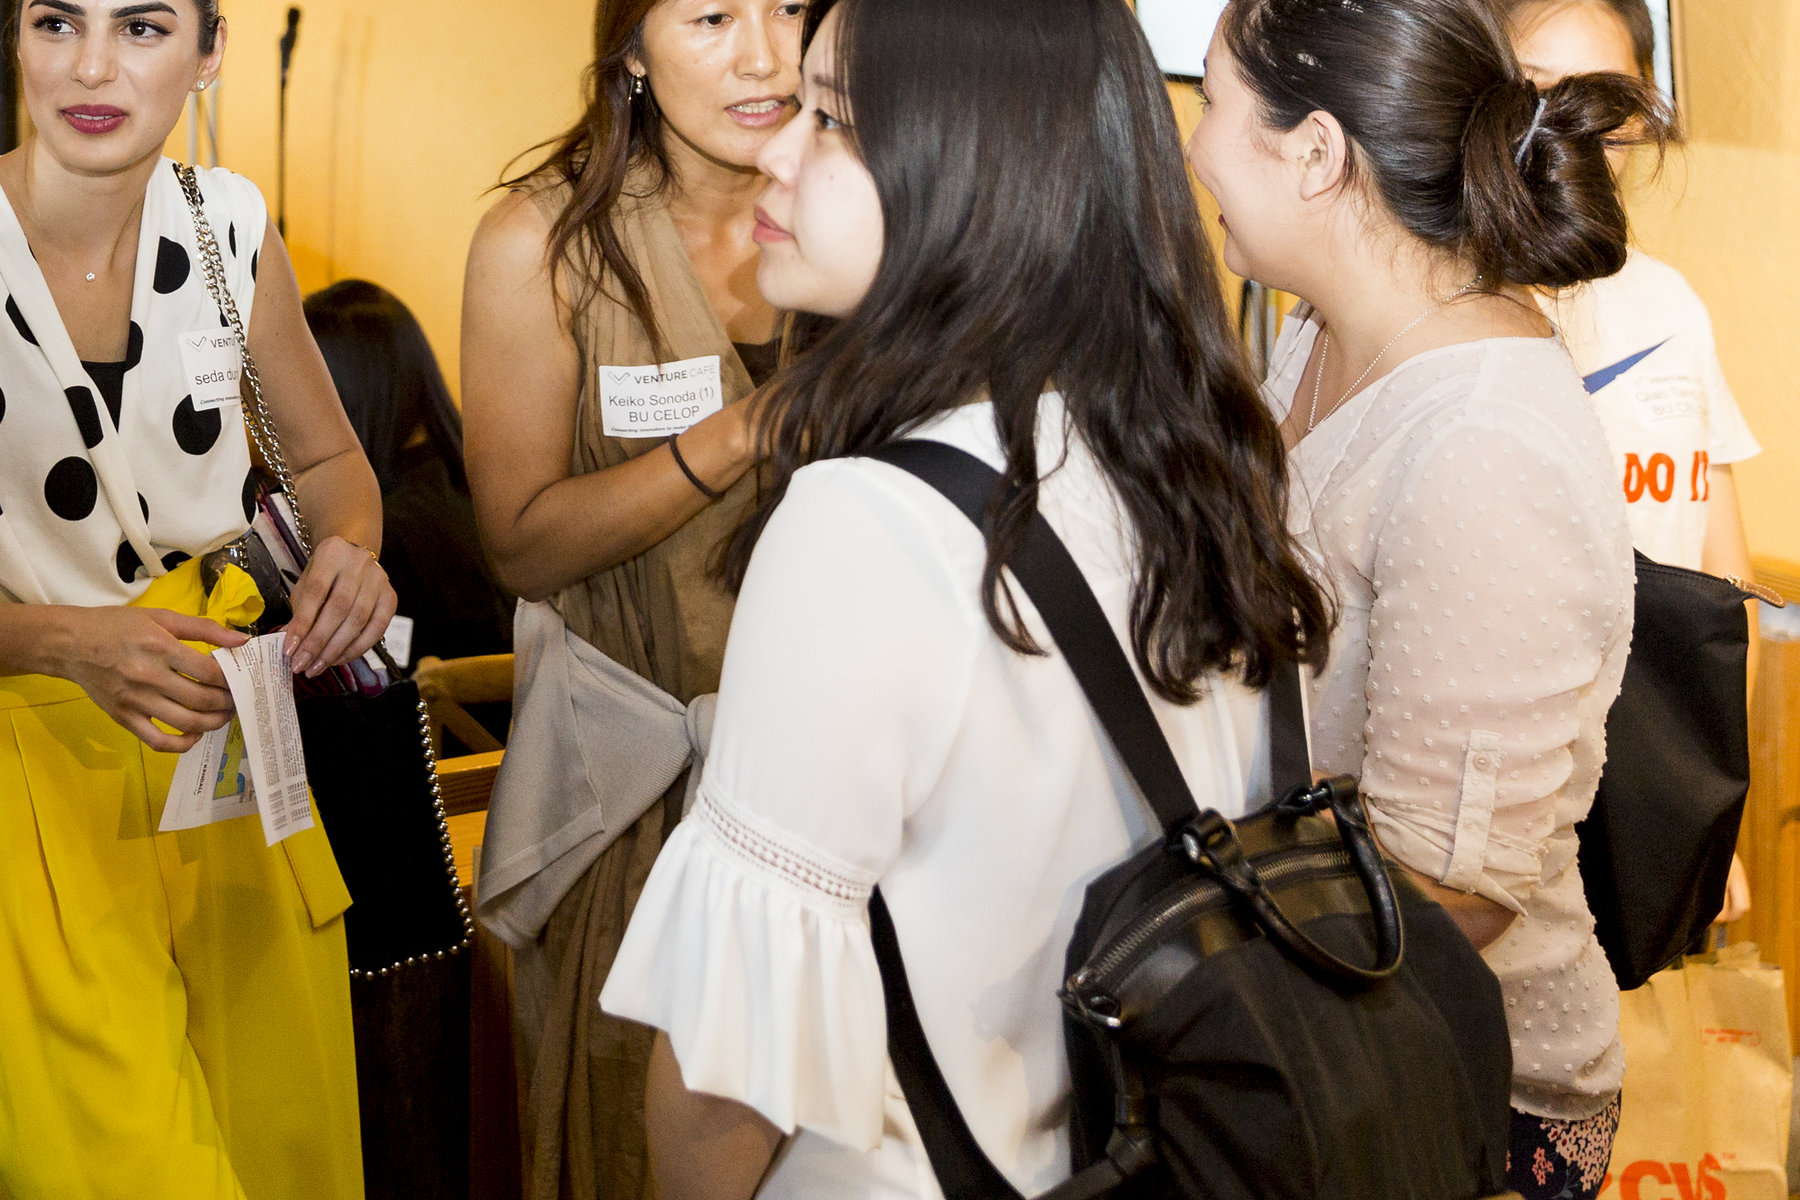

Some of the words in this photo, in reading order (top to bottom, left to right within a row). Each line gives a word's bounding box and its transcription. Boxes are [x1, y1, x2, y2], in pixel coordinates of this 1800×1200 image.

[195, 370, 224, 385] seda
[634, 370, 688, 384] VENTURE
[608, 395, 645, 406] Keiko
[649, 391, 696, 406] Sonoda
[699, 386, 714, 401] (1)
[629, 411, 648, 422] BU
[653, 405, 700, 421] CELOP
[1623, 452, 1675, 503] DO
